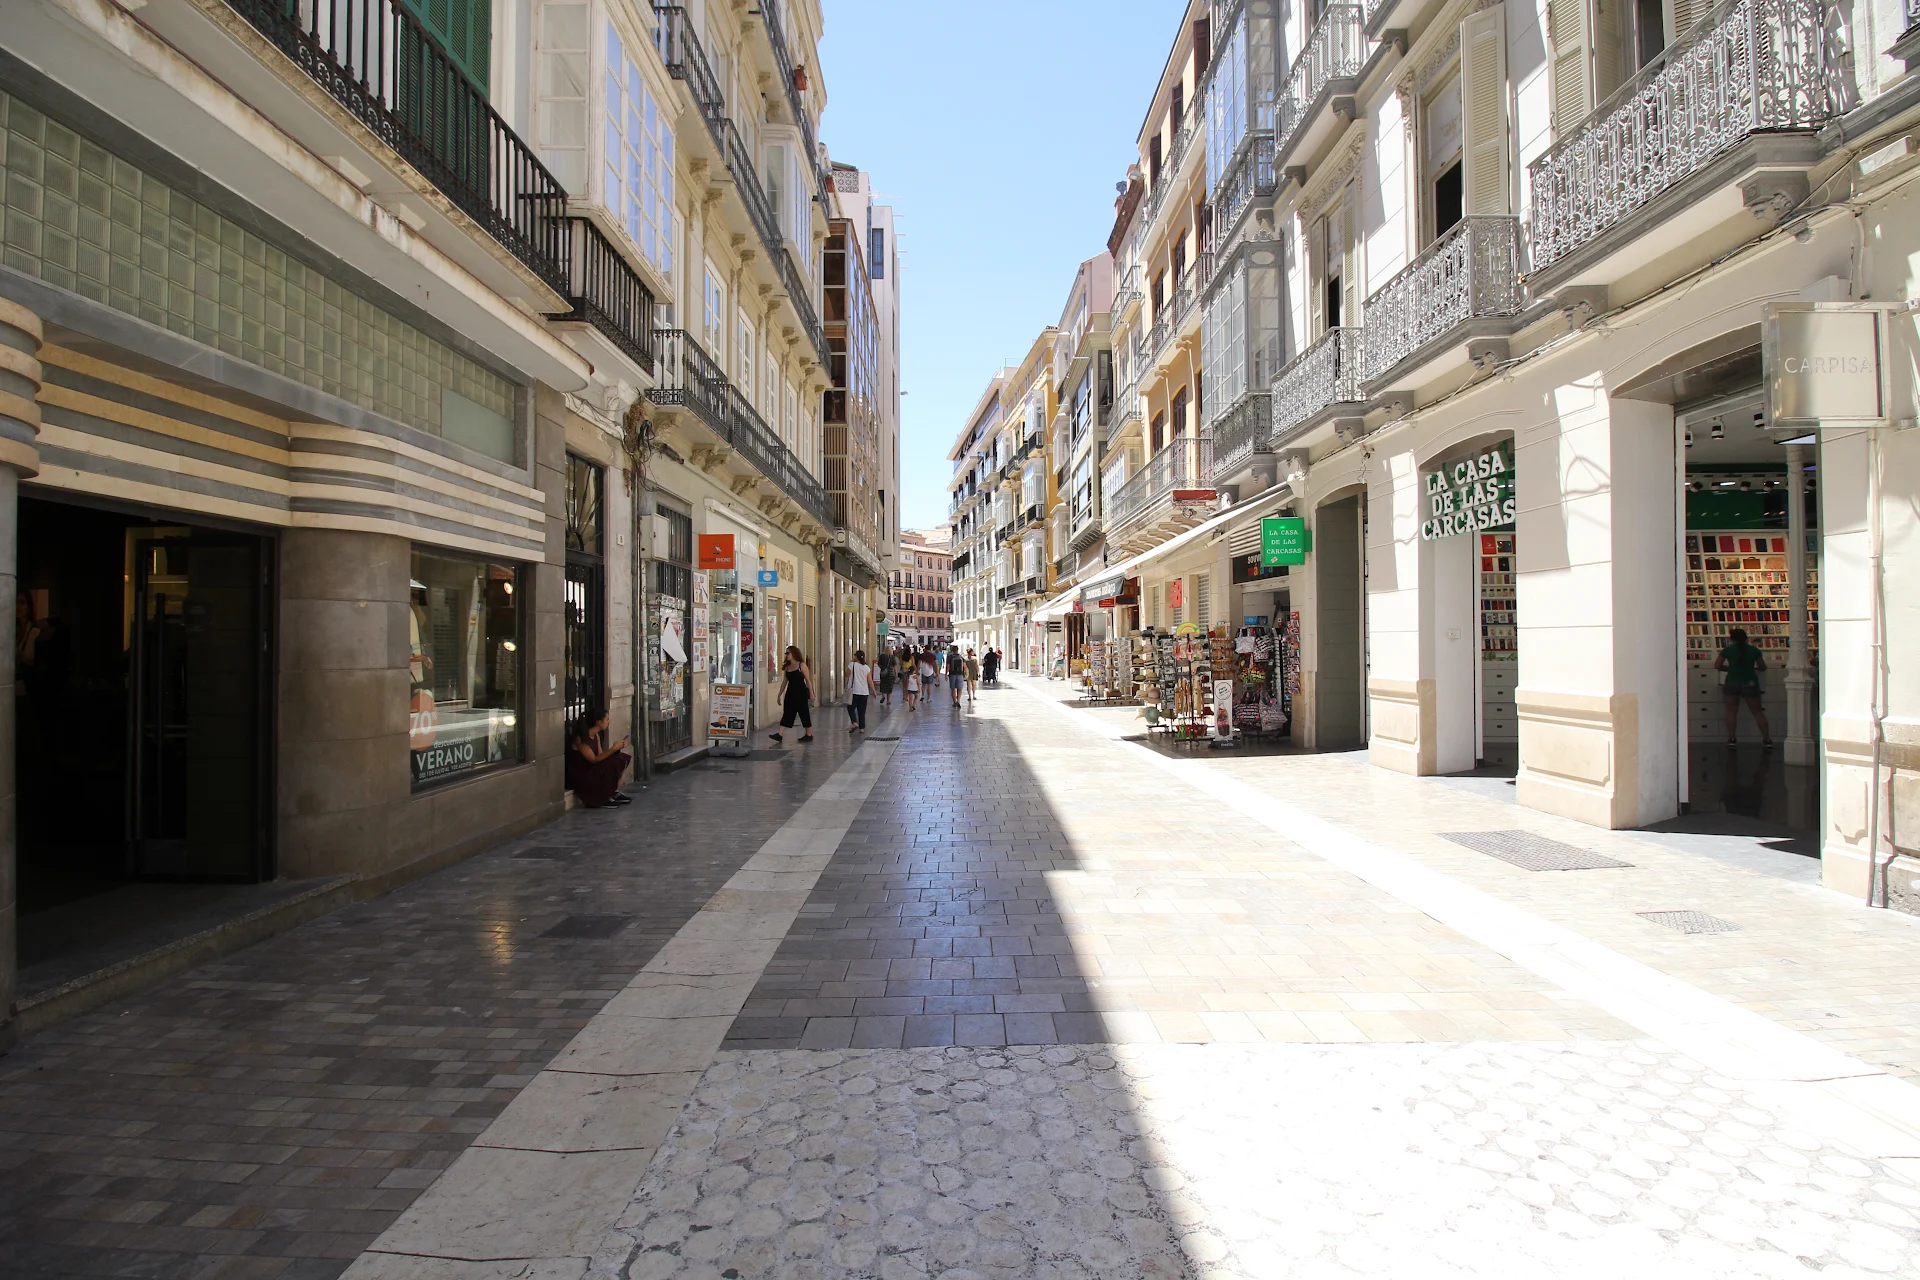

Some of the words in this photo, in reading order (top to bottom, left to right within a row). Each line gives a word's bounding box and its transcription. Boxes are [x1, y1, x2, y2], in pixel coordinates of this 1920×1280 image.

[1784, 356, 1873, 374] CARPISA
[1425, 470, 1449, 496] LA
[1454, 450, 1505, 485] CASA
[1432, 491, 1454, 517] DE
[1460, 477, 1499, 509] LAS
[1421, 498, 1516, 541] CARCASAS
[1266, 547, 1302, 555] CARCASAS
[417, 744, 473, 771] VERANO
